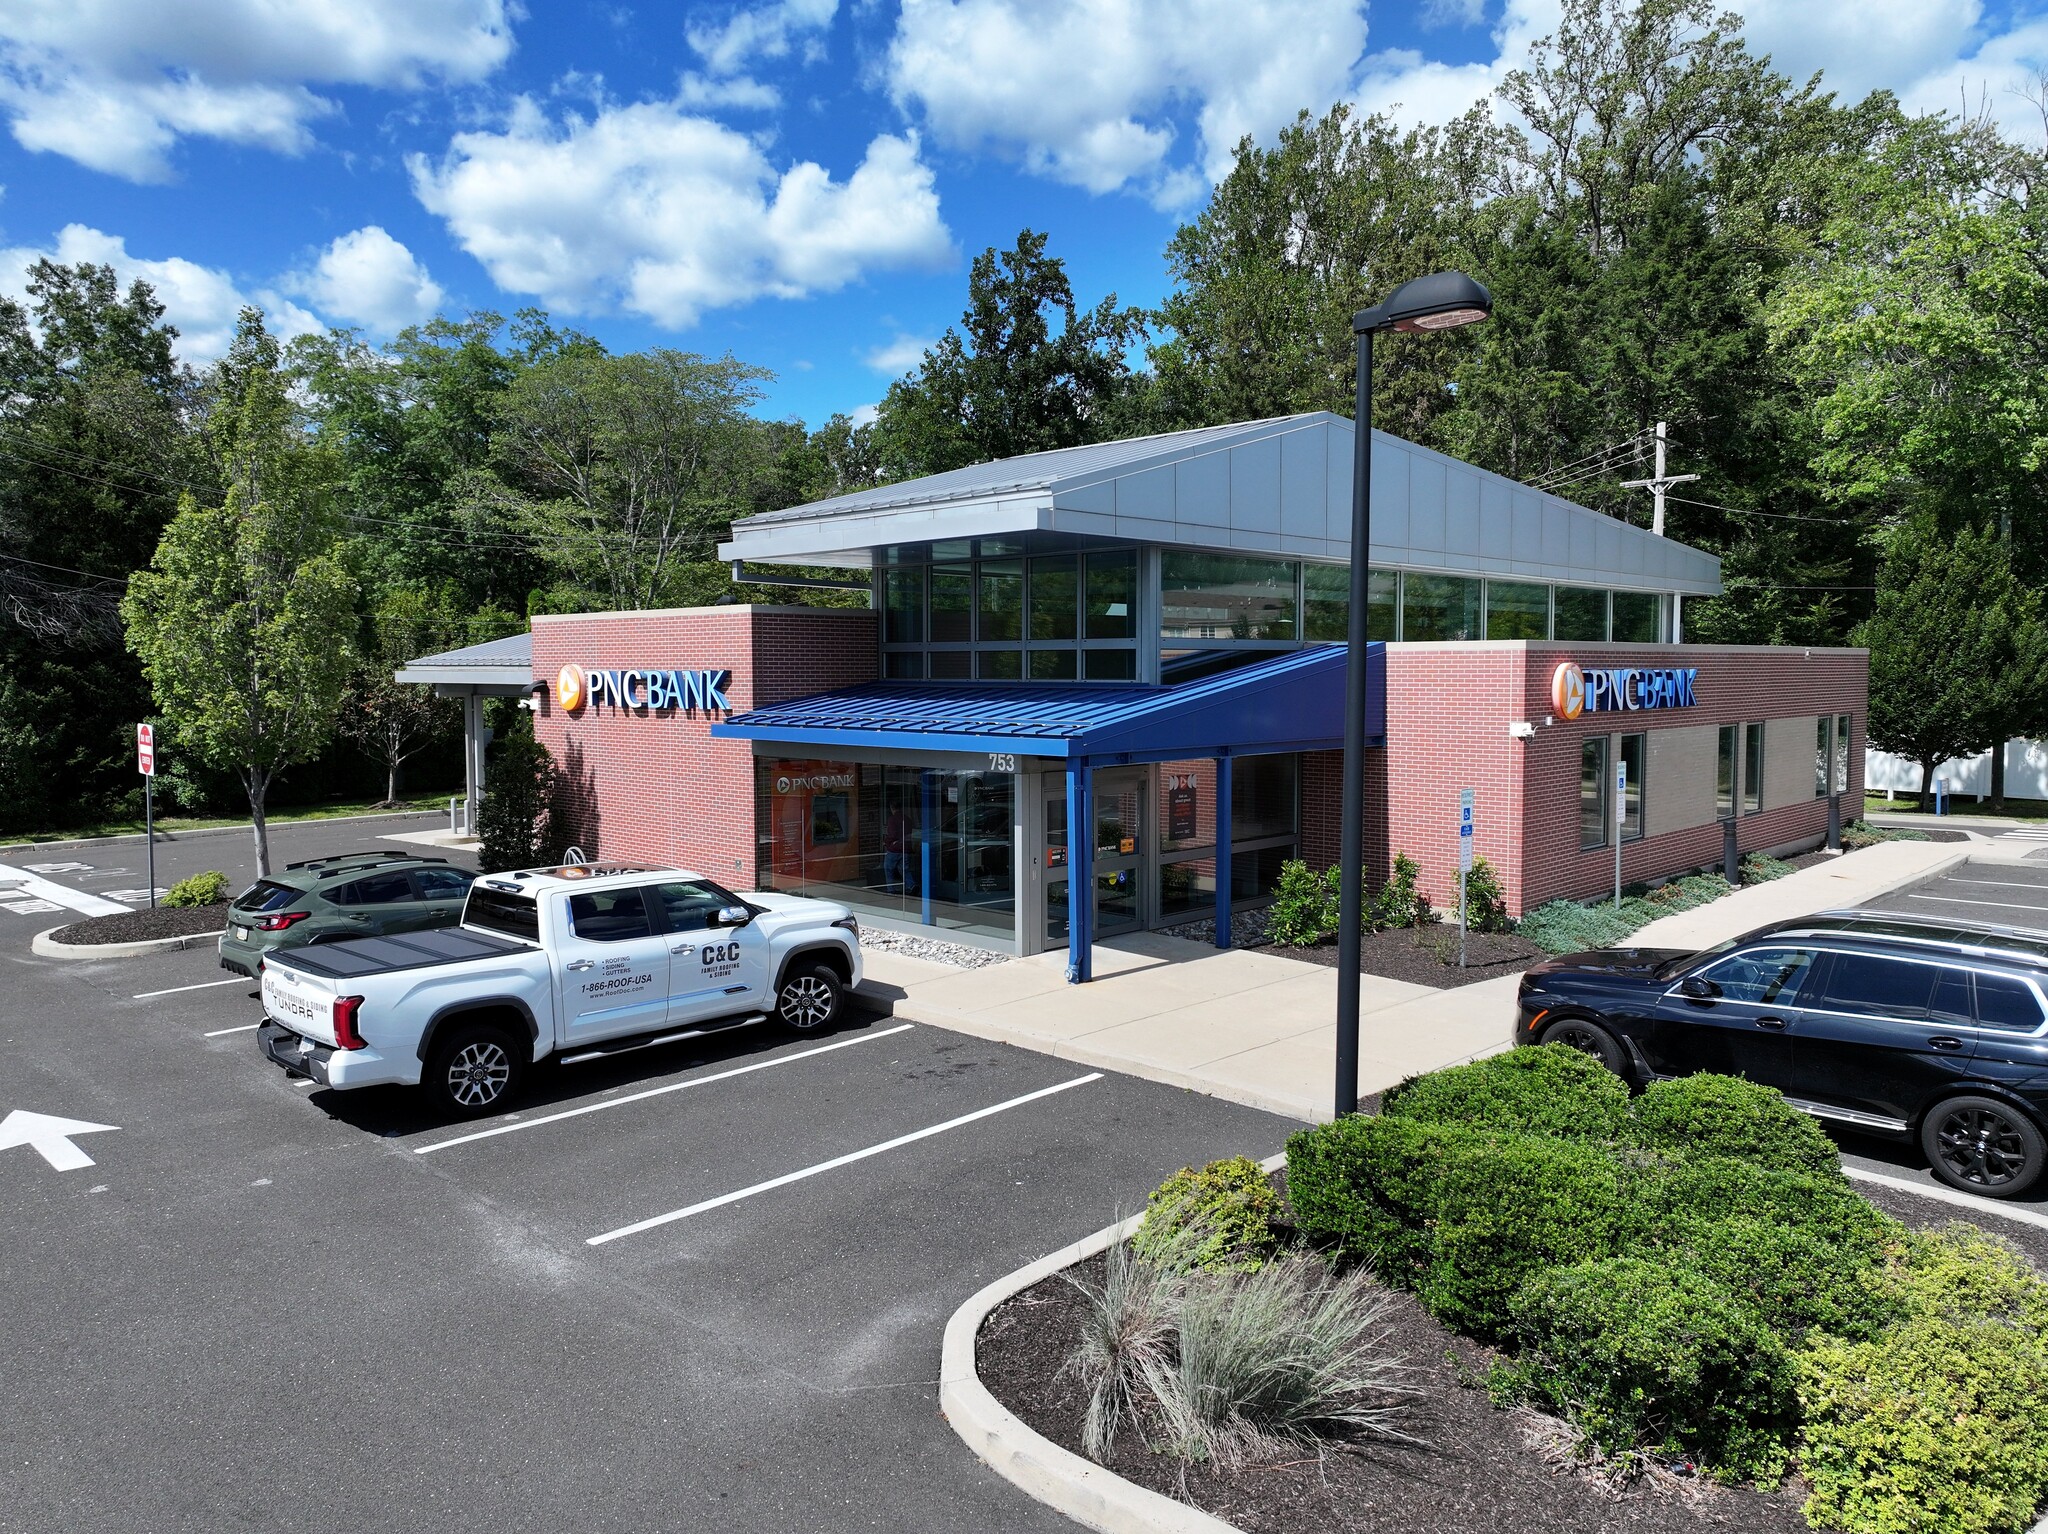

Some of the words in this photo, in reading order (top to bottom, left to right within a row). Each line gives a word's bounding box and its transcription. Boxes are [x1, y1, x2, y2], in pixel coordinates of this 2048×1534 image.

[585, 670, 642, 708] PNC
[645, 670, 732, 710] BANK
[1590, 668, 1640, 712] PNC
[1642, 668, 1697, 709] BANK
[989, 753, 1015, 772] 753
[605, 956, 631, 965] ROOFING
[702, 942, 740, 965] C&C
[606, 968, 631, 976] GUTTERS
[701, 965, 718, 974] FAMILY
[719, 963, 740, 972] ROOFING
[714, 970, 732, 978] SIDING
[581, 974, 652, 993] 1-866-ROOF-USA
[590, 986, 645, 999] www.RoofDoc.com
[273, 995, 314, 1020] TUNDRA
[287, 992, 305, 1006] ROOFING
[310, 1001, 328, 1014] SIDING
